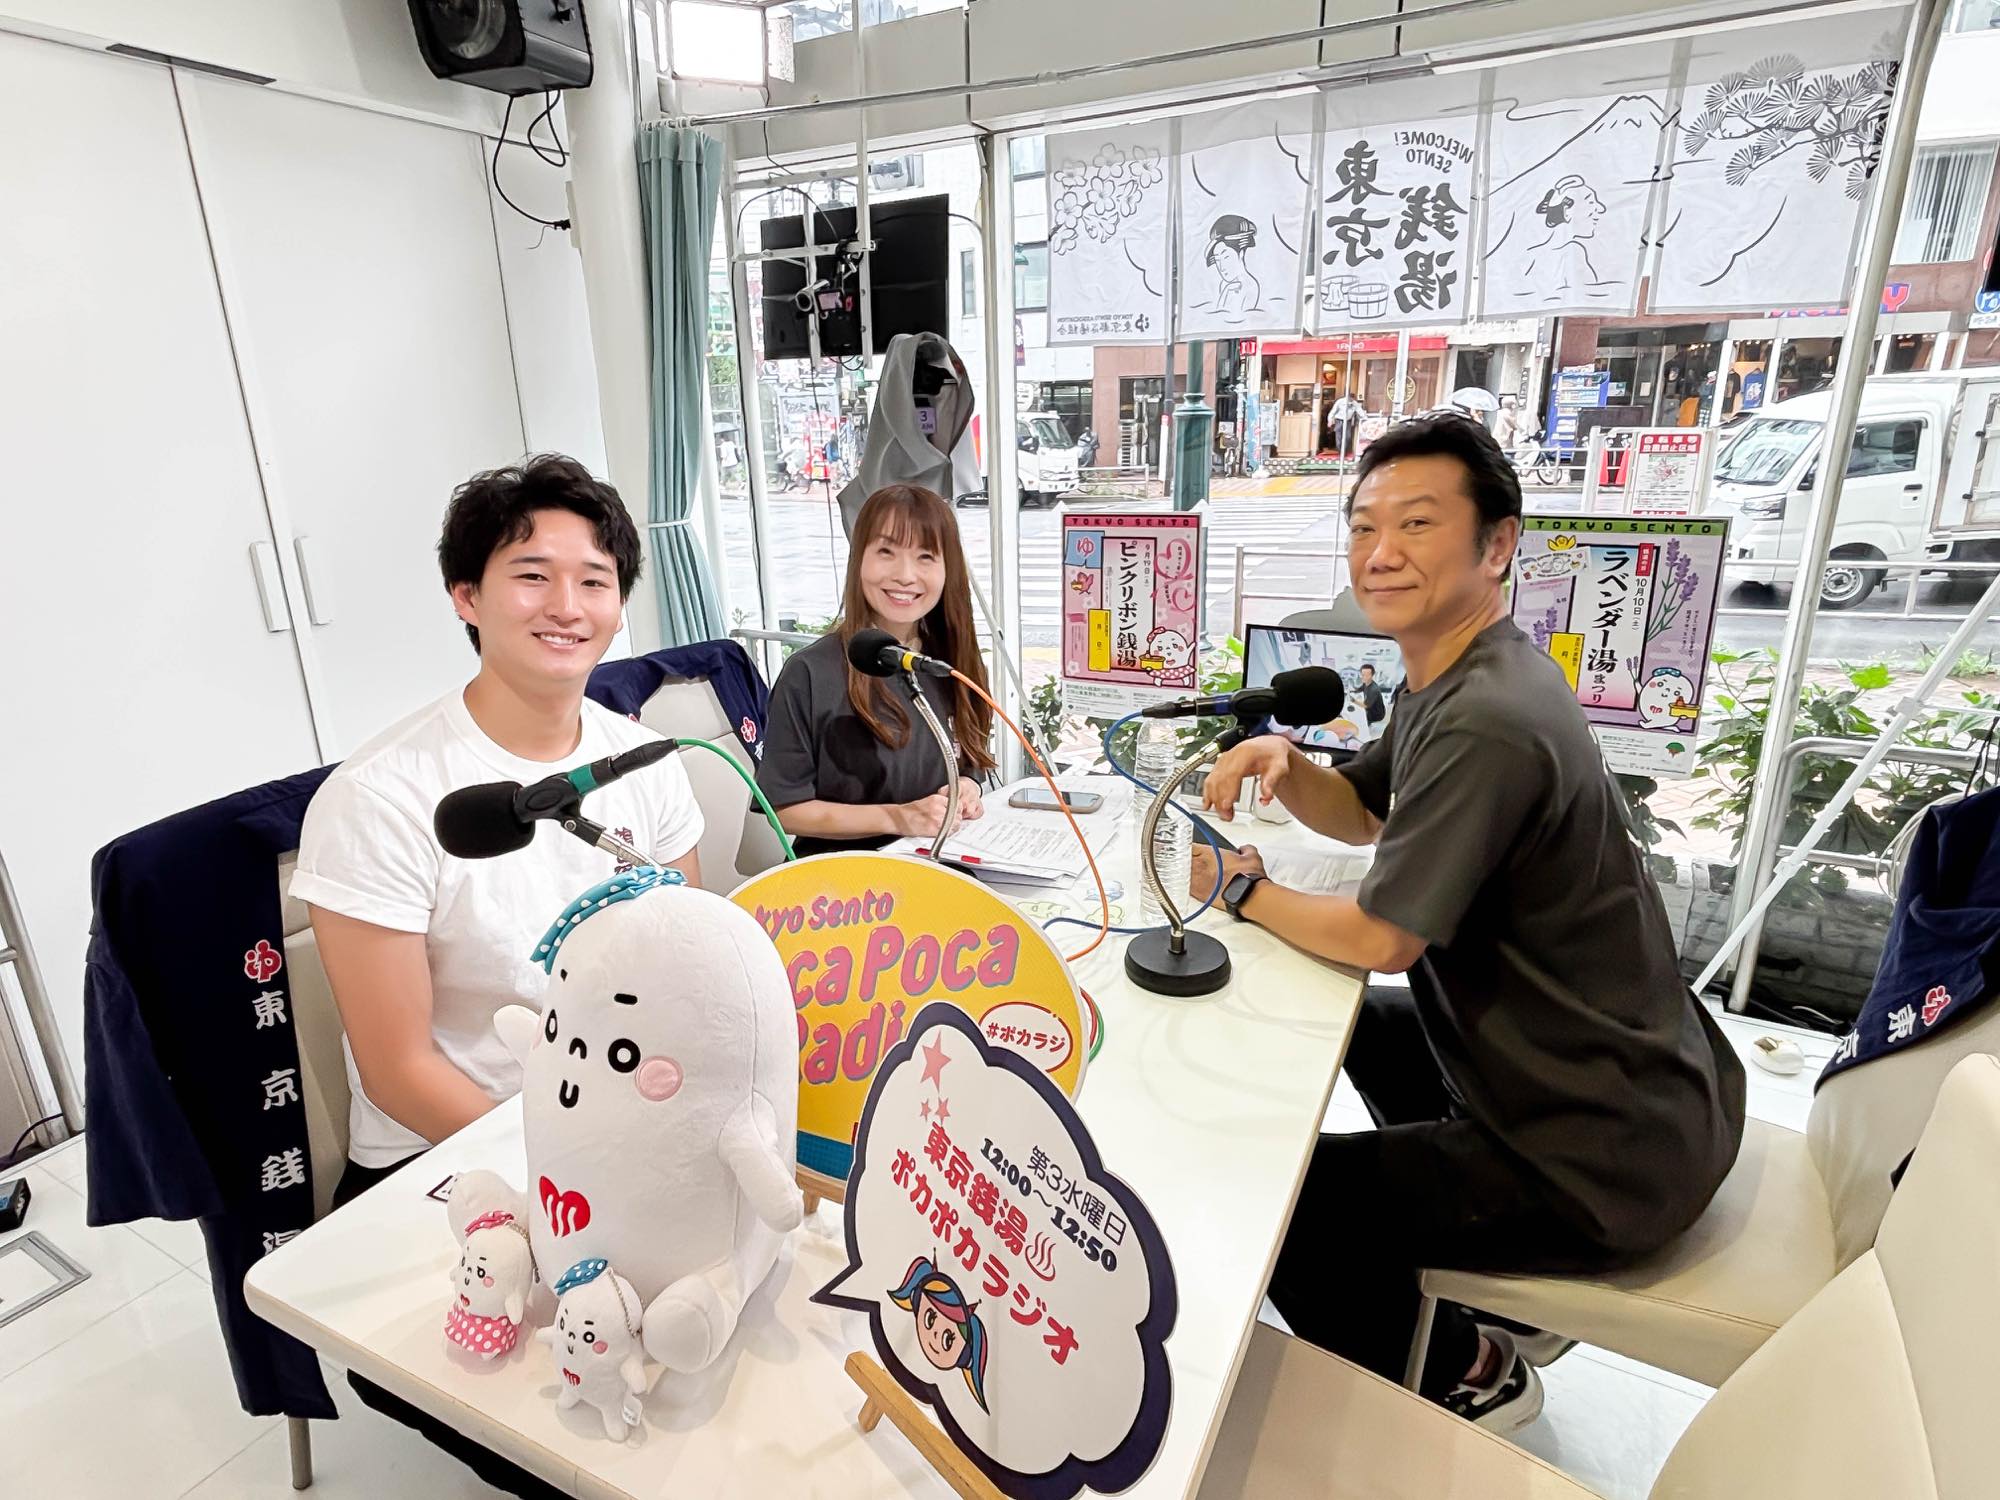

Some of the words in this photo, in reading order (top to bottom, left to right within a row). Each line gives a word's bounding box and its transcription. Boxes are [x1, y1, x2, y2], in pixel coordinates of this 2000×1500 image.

[1072, 518, 1124, 526] TOKYO
[1076, 537, 1095, 557] ゆ
[1537, 520, 1613, 531] TOKYO
[1630, 523, 1711, 534] SENTO
[1117, 541, 1139, 668] ピンクリボン銭湯
[755, 904, 805, 942] kyo
[808, 888, 894, 931] Sento
[787, 945, 853, 1009] ca
[859, 924, 1020, 1001] Poca
[797, 1000, 906, 1085] adi
[985, 1022, 1066, 1053] #ポカラジ
[923, 1121, 1031, 1257] 東京銭湯
[1026, 1144, 1128, 1248] 第3水曜日
[890, 1148, 1081, 1366] ポカポカラジオ
